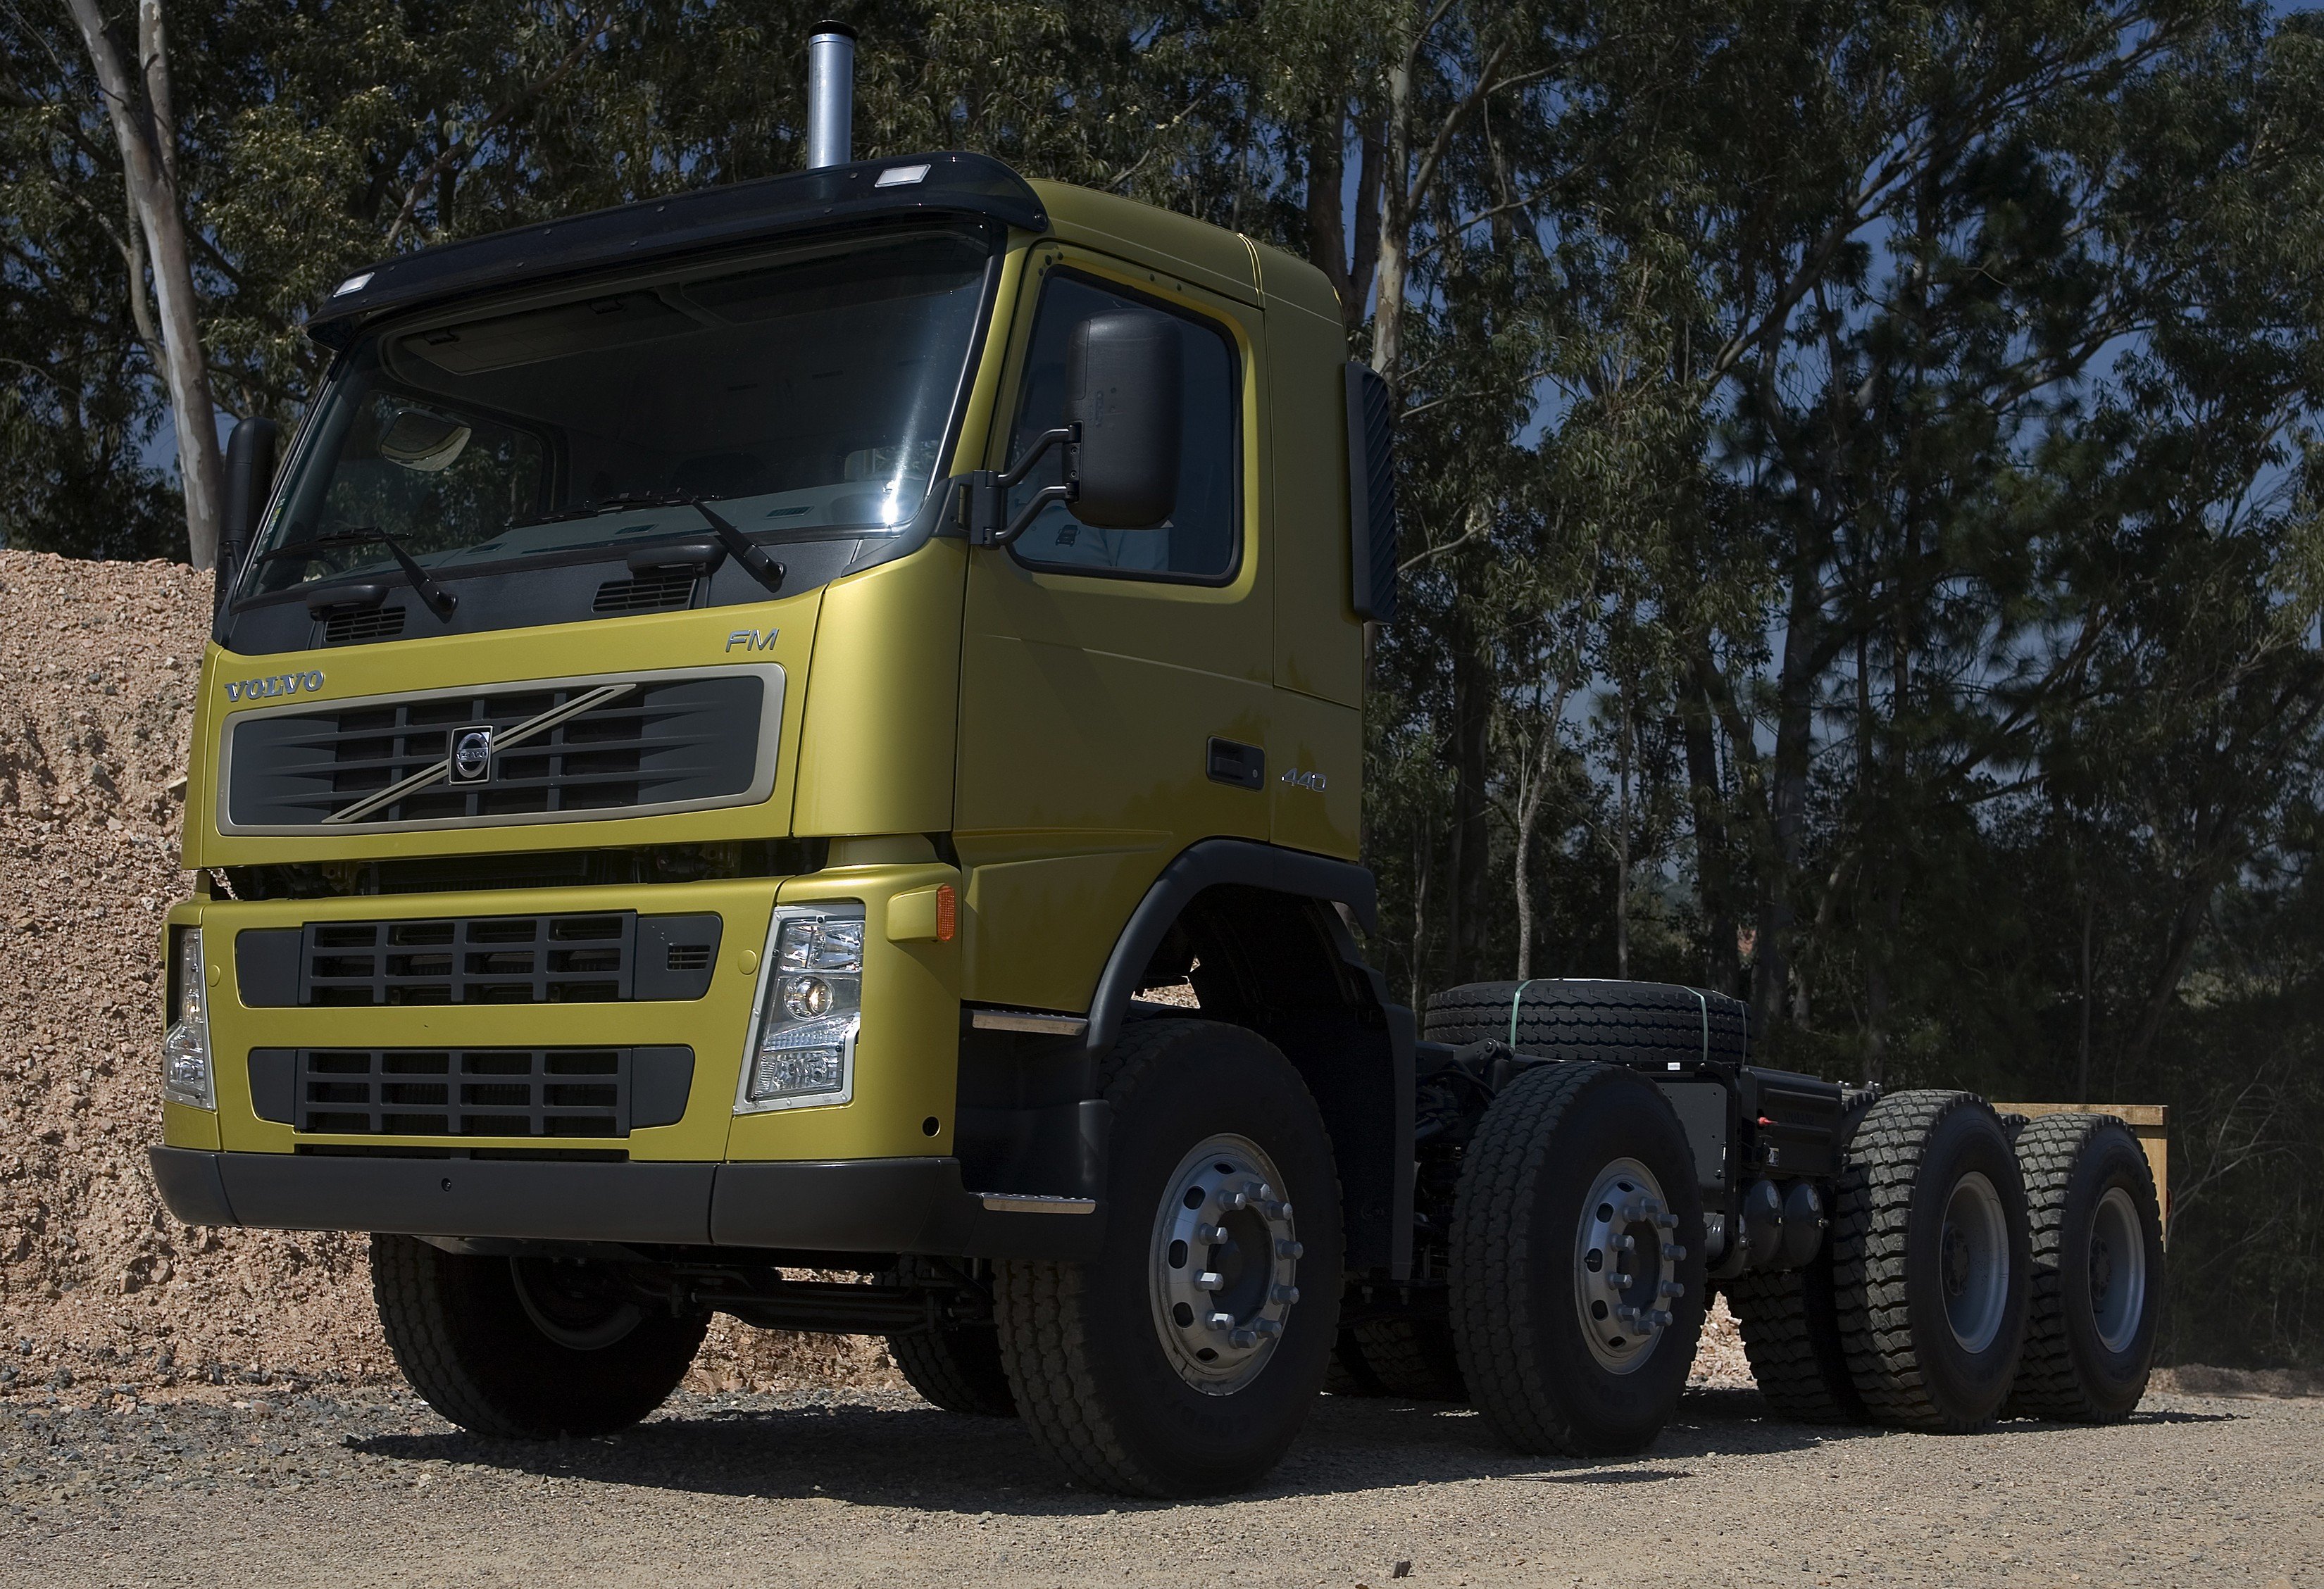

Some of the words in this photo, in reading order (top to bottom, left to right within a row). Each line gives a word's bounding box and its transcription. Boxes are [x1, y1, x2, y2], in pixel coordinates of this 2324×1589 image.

[725, 628, 779, 653] FM
[225, 670, 325, 703] VOLVO
[1281, 767, 1327, 792] 440
